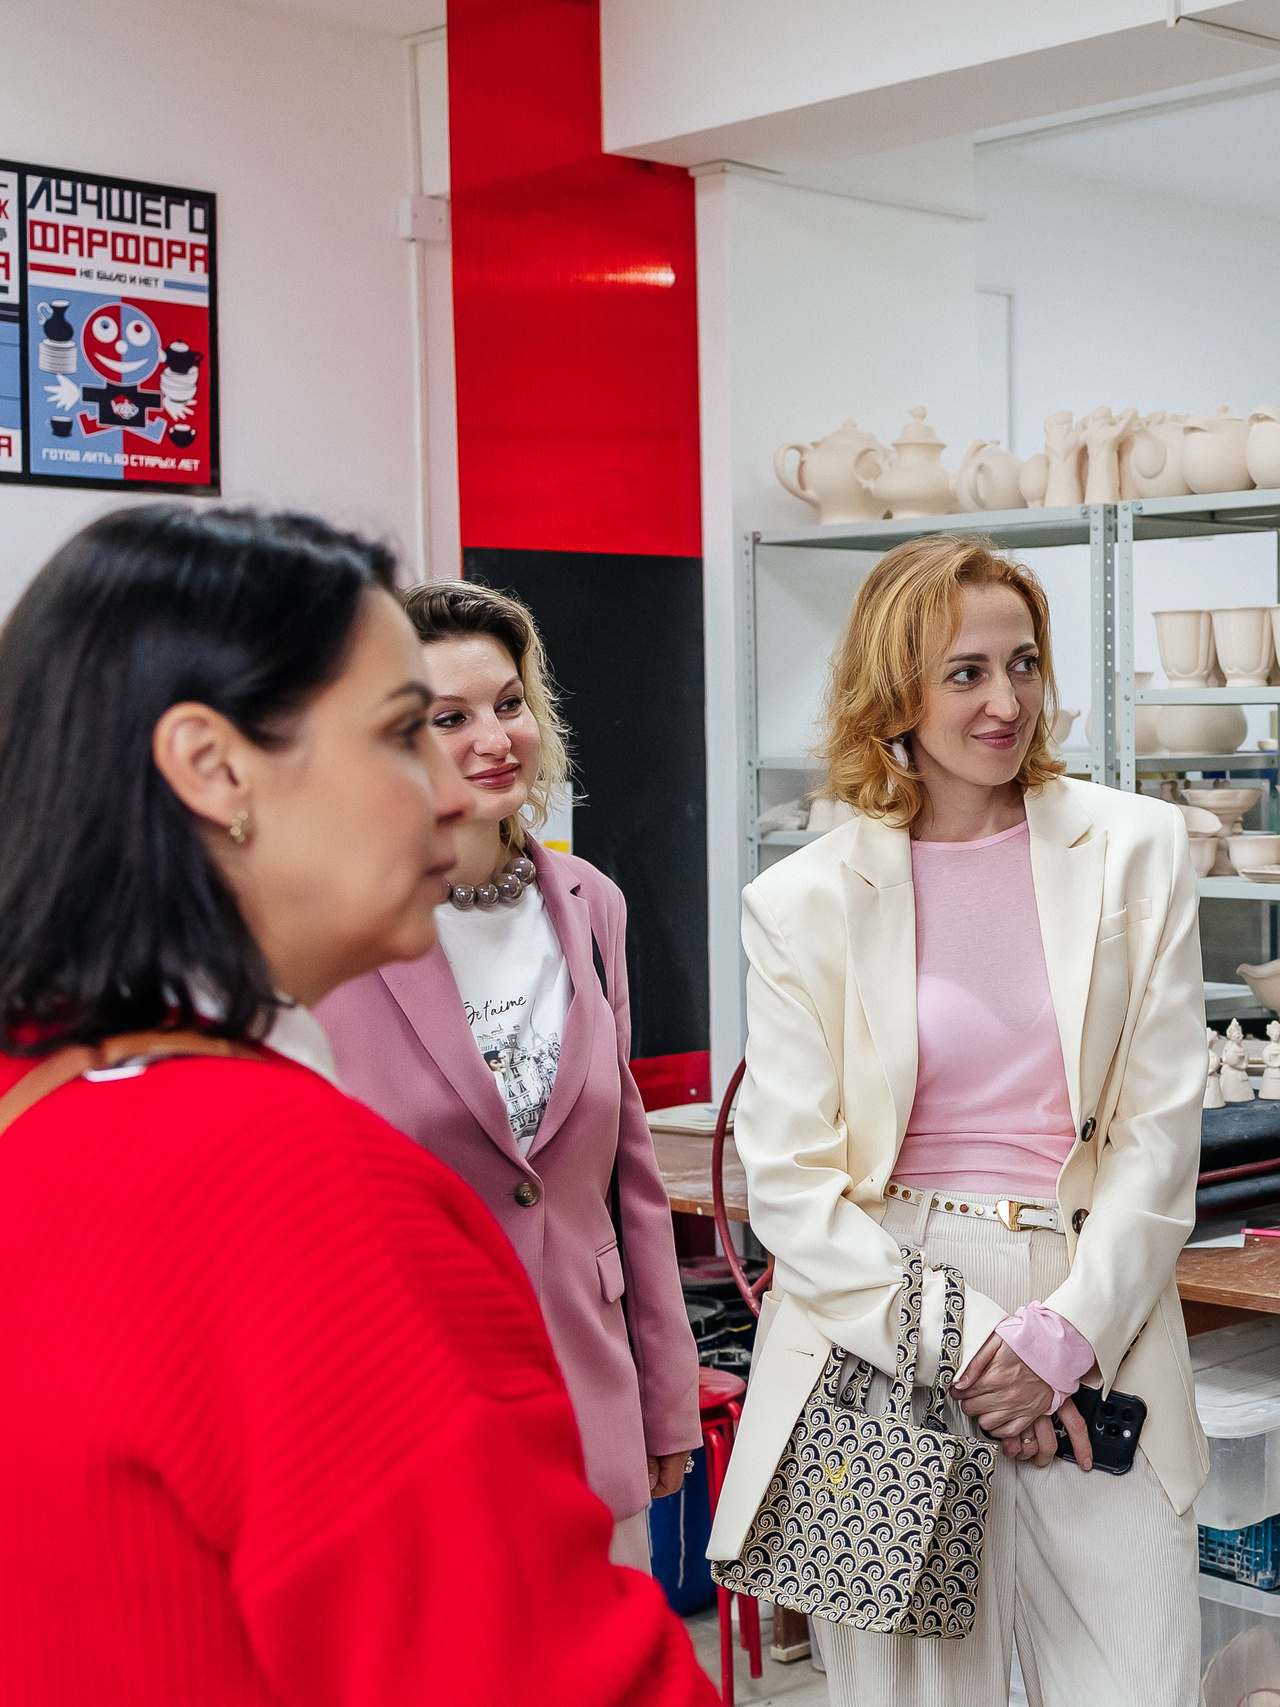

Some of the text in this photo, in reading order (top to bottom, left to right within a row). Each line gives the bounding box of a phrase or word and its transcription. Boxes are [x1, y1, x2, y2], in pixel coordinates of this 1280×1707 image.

[27, 177, 209, 234] ЛУЧШЕГО
[29, 219, 209, 274] ФАРФОРА
[79, 269, 161, 288] НЕ БЫЛО И НЕТ
[41, 447, 81, 463] ГОТОВ
[129, 454, 177, 470] СТАРЫХ
[177, 458, 201, 472] ЛЕТ
